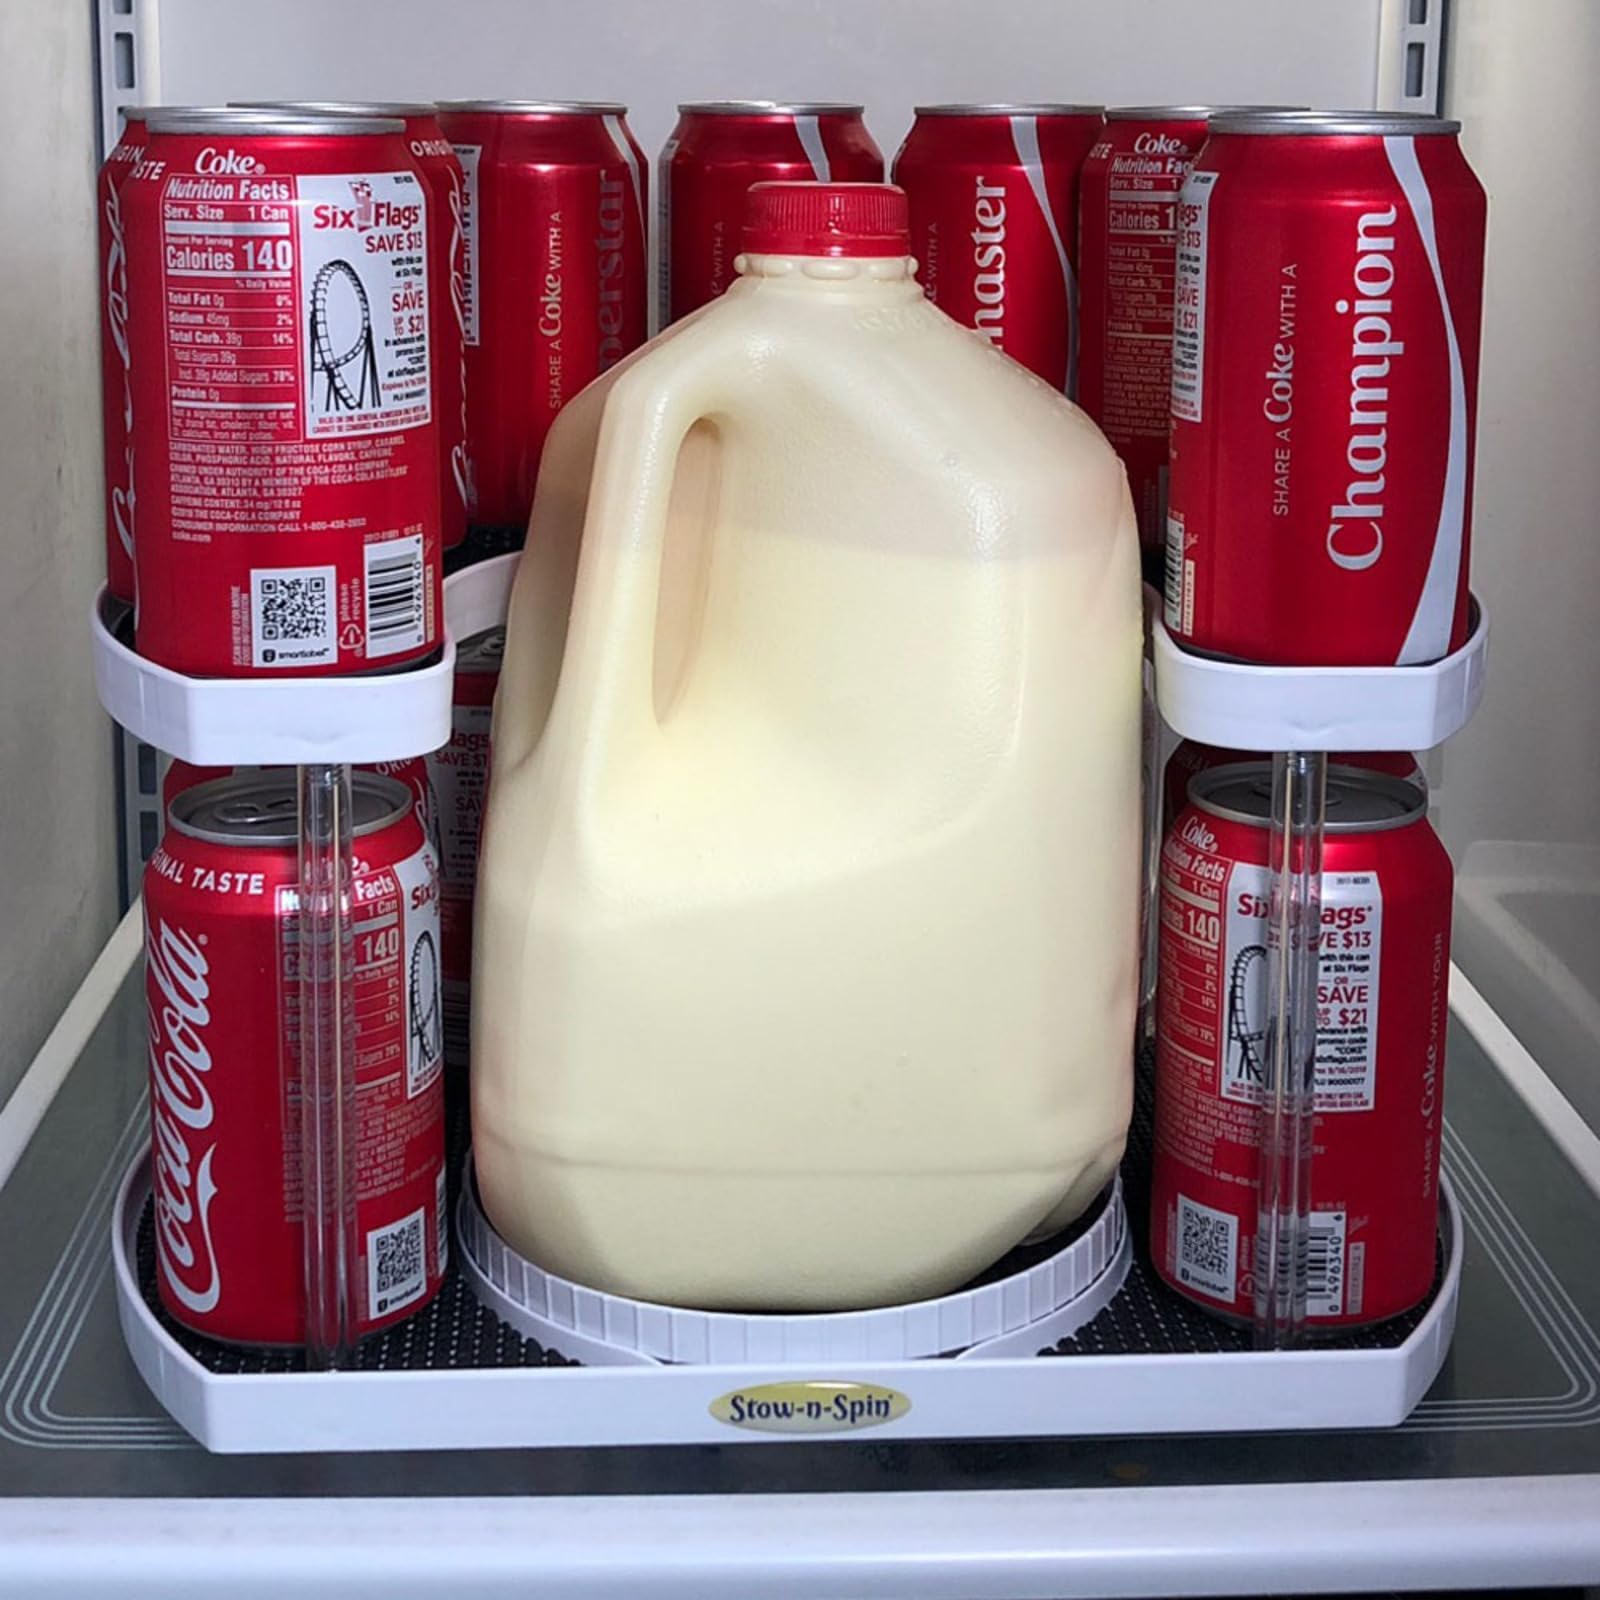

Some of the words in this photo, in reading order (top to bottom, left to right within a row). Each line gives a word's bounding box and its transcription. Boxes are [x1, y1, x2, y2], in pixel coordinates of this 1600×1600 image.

[1111, 157, 1162, 174] Nutrition
[166, 179, 234, 201] Nutrition
[239, 181, 290, 201] Facts
[164, 204, 193, 219] Serv.
[197, 206, 224, 220] Size
[248, 207, 256, 220] 1
[261, 207, 289, 221] Can
[313, 203, 356, 229] Six
[374, 201, 421, 230] Flags
[549, 211, 562, 223] A
[1109, 210, 1160, 230] Calories
[366, 233, 404, 254] SAVE
[406, 231, 423, 251] $13
[549, 227, 562, 272] WITH
[166, 246, 235, 270] Calories
[242, 241, 293, 271] 140
[1281, 263, 1298, 279] A
[168, 291, 192, 304] Total
[193, 293, 211, 305] Fat
[392, 290, 424, 312] SAVE
[538, 273, 562, 338] Coke
[1279, 285, 1297, 339] WITH
[549, 339, 562, 351] A
[549, 356, 562, 410] SHARE
[1263, 343, 1295, 423] Coke
[1326, 204, 1405, 571] Champion
[1276, 427, 1292, 442] A
[1273, 448, 1291, 516] SHARE
[1181, 816, 1216, 851] Coke
[192, 867, 265, 895] TASTE
[1192, 855, 1225, 882] Facts
[354, 875, 395, 902] Facts
[1200, 882, 1220, 900] Can
[378, 899, 398, 915] Can
[1187, 908, 1220, 945] 140
[362, 927, 399, 964] 140
[1342, 930, 1372, 950] $13
[1334, 976, 1349, 985] OR
[1317, 985, 1369, 1005] SAVE
[1338, 1007, 1368, 1026] $21
[1420, 1044, 1438, 1118] Coke
[729, 1393, 893, 1425] Stow-n-Spin
